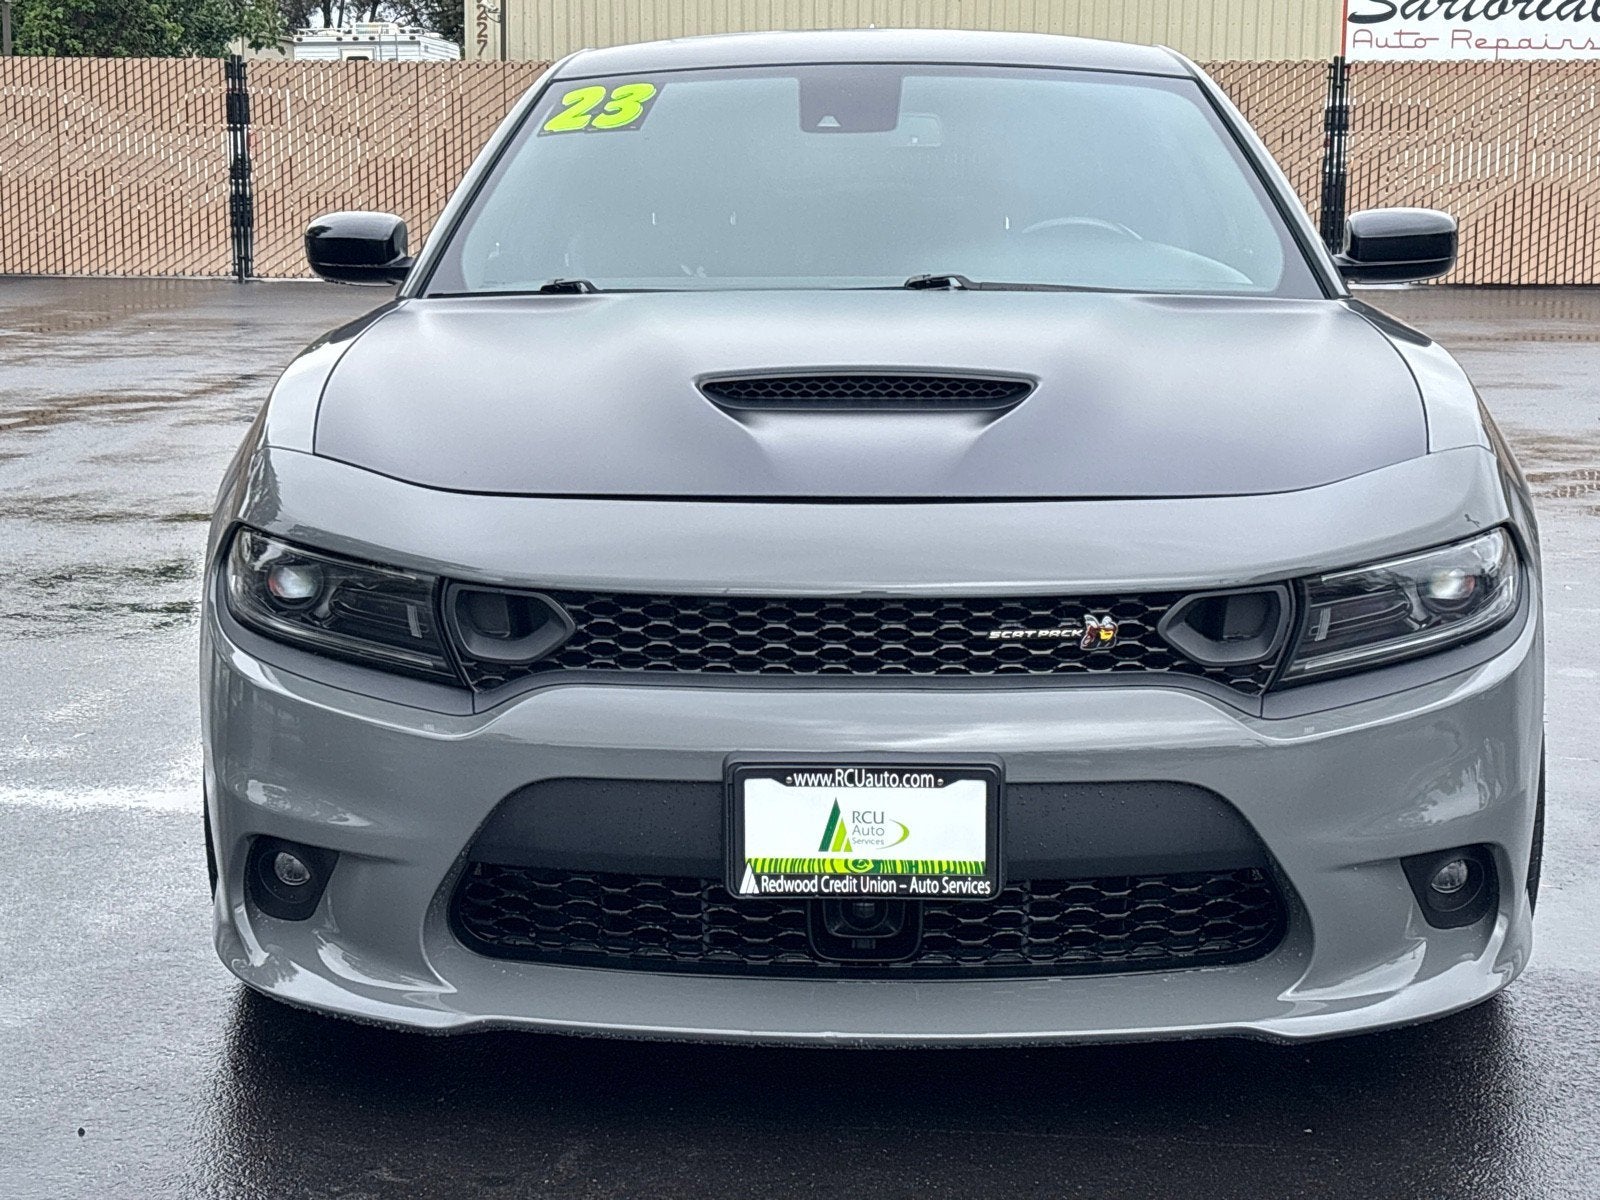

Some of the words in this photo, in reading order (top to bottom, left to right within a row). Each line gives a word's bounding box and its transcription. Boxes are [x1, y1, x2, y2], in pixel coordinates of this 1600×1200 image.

[476, 0, 488, 56] 227
[1353, 29, 1439, 49] Auto
[1451, 29, 1600, 60] Repairs
[543, 83, 657, 132] 23
[988, 630, 1037, 639] SCAT
[1037, 629, 1083, 638] PACK
[793, 769, 935, 788] www.RCUauto.com
[852, 810, 884, 824] RCU
[852, 824, 885, 836] Auto
[852, 837, 885, 846] Services
[761, 876, 818, 893] Redwood
[820, 876, 858, 893] Credit
[860, 876, 897, 893] Union
[909, 877, 940, 894] Auto
[942, 877, 991, 894] Services
